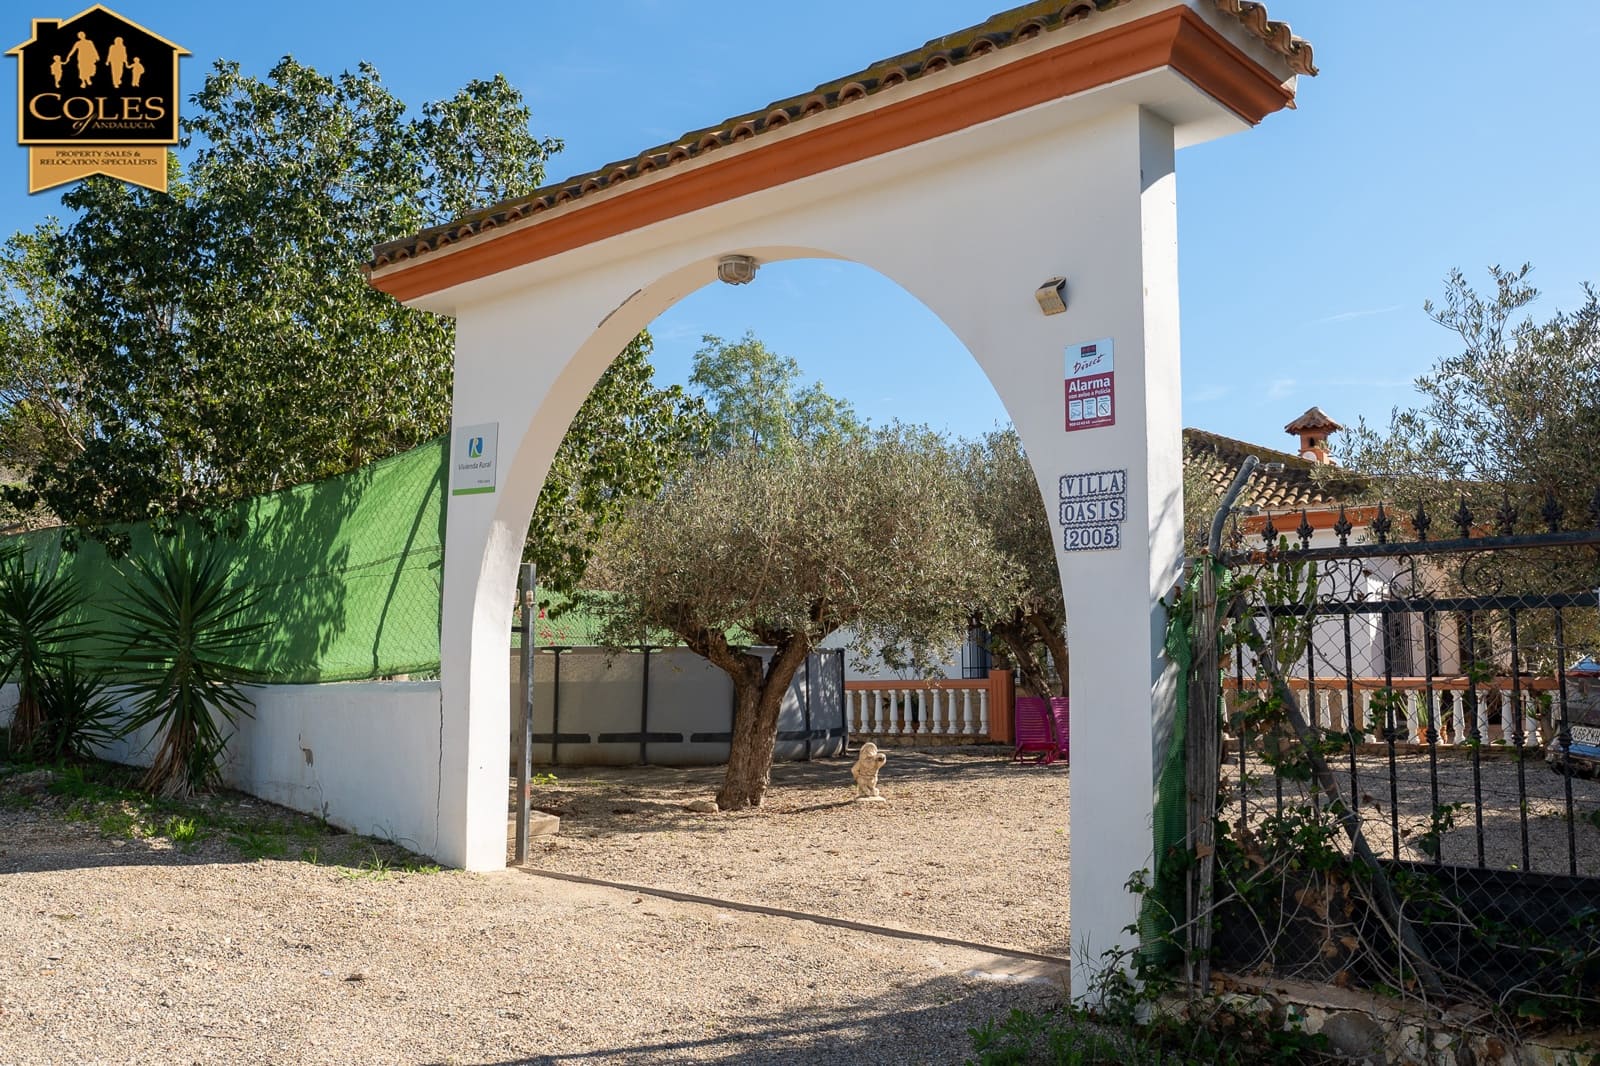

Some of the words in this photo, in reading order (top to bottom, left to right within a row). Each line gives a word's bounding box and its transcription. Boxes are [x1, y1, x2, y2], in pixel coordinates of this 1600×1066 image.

[1073, 353, 1105, 374] Direct
[1068, 377, 1111, 393] Alarma
[479, 460, 491, 469] Rural
[1064, 473, 1120, 496] VILLA
[1064, 500, 1120, 522] OASIS
[1069, 527, 1114, 547] 2005
